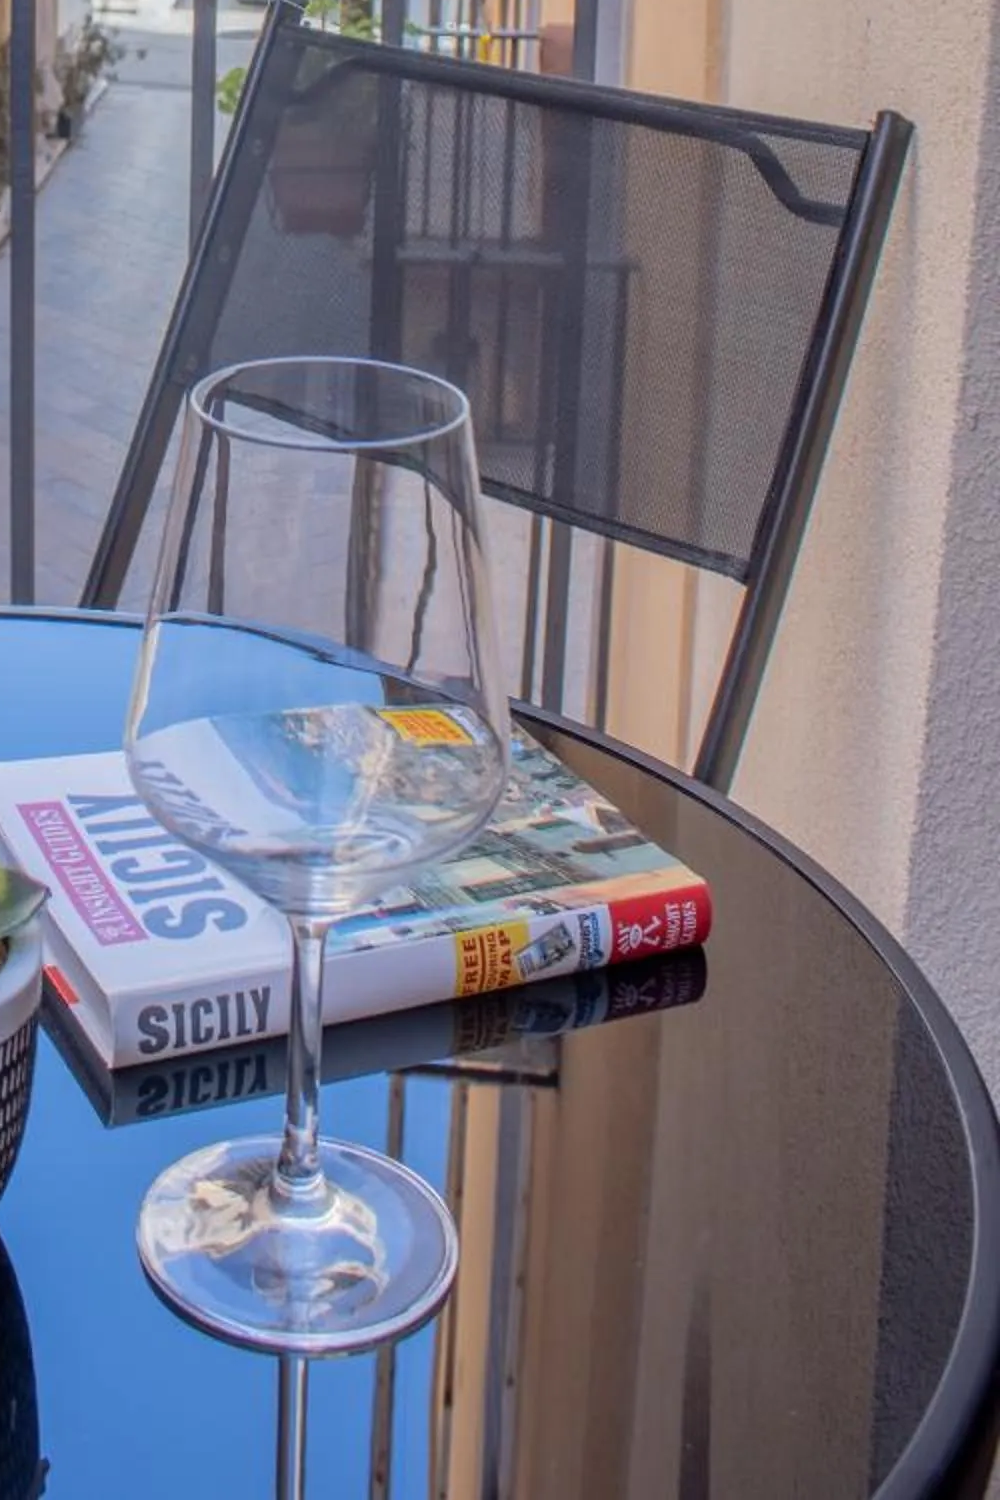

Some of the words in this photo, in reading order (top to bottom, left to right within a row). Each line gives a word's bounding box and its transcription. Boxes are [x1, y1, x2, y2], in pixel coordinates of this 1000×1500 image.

[66, 793, 249, 940] SICILY
[462, 936, 479, 996] FREE
[136, 985, 271, 1054] SICILY
